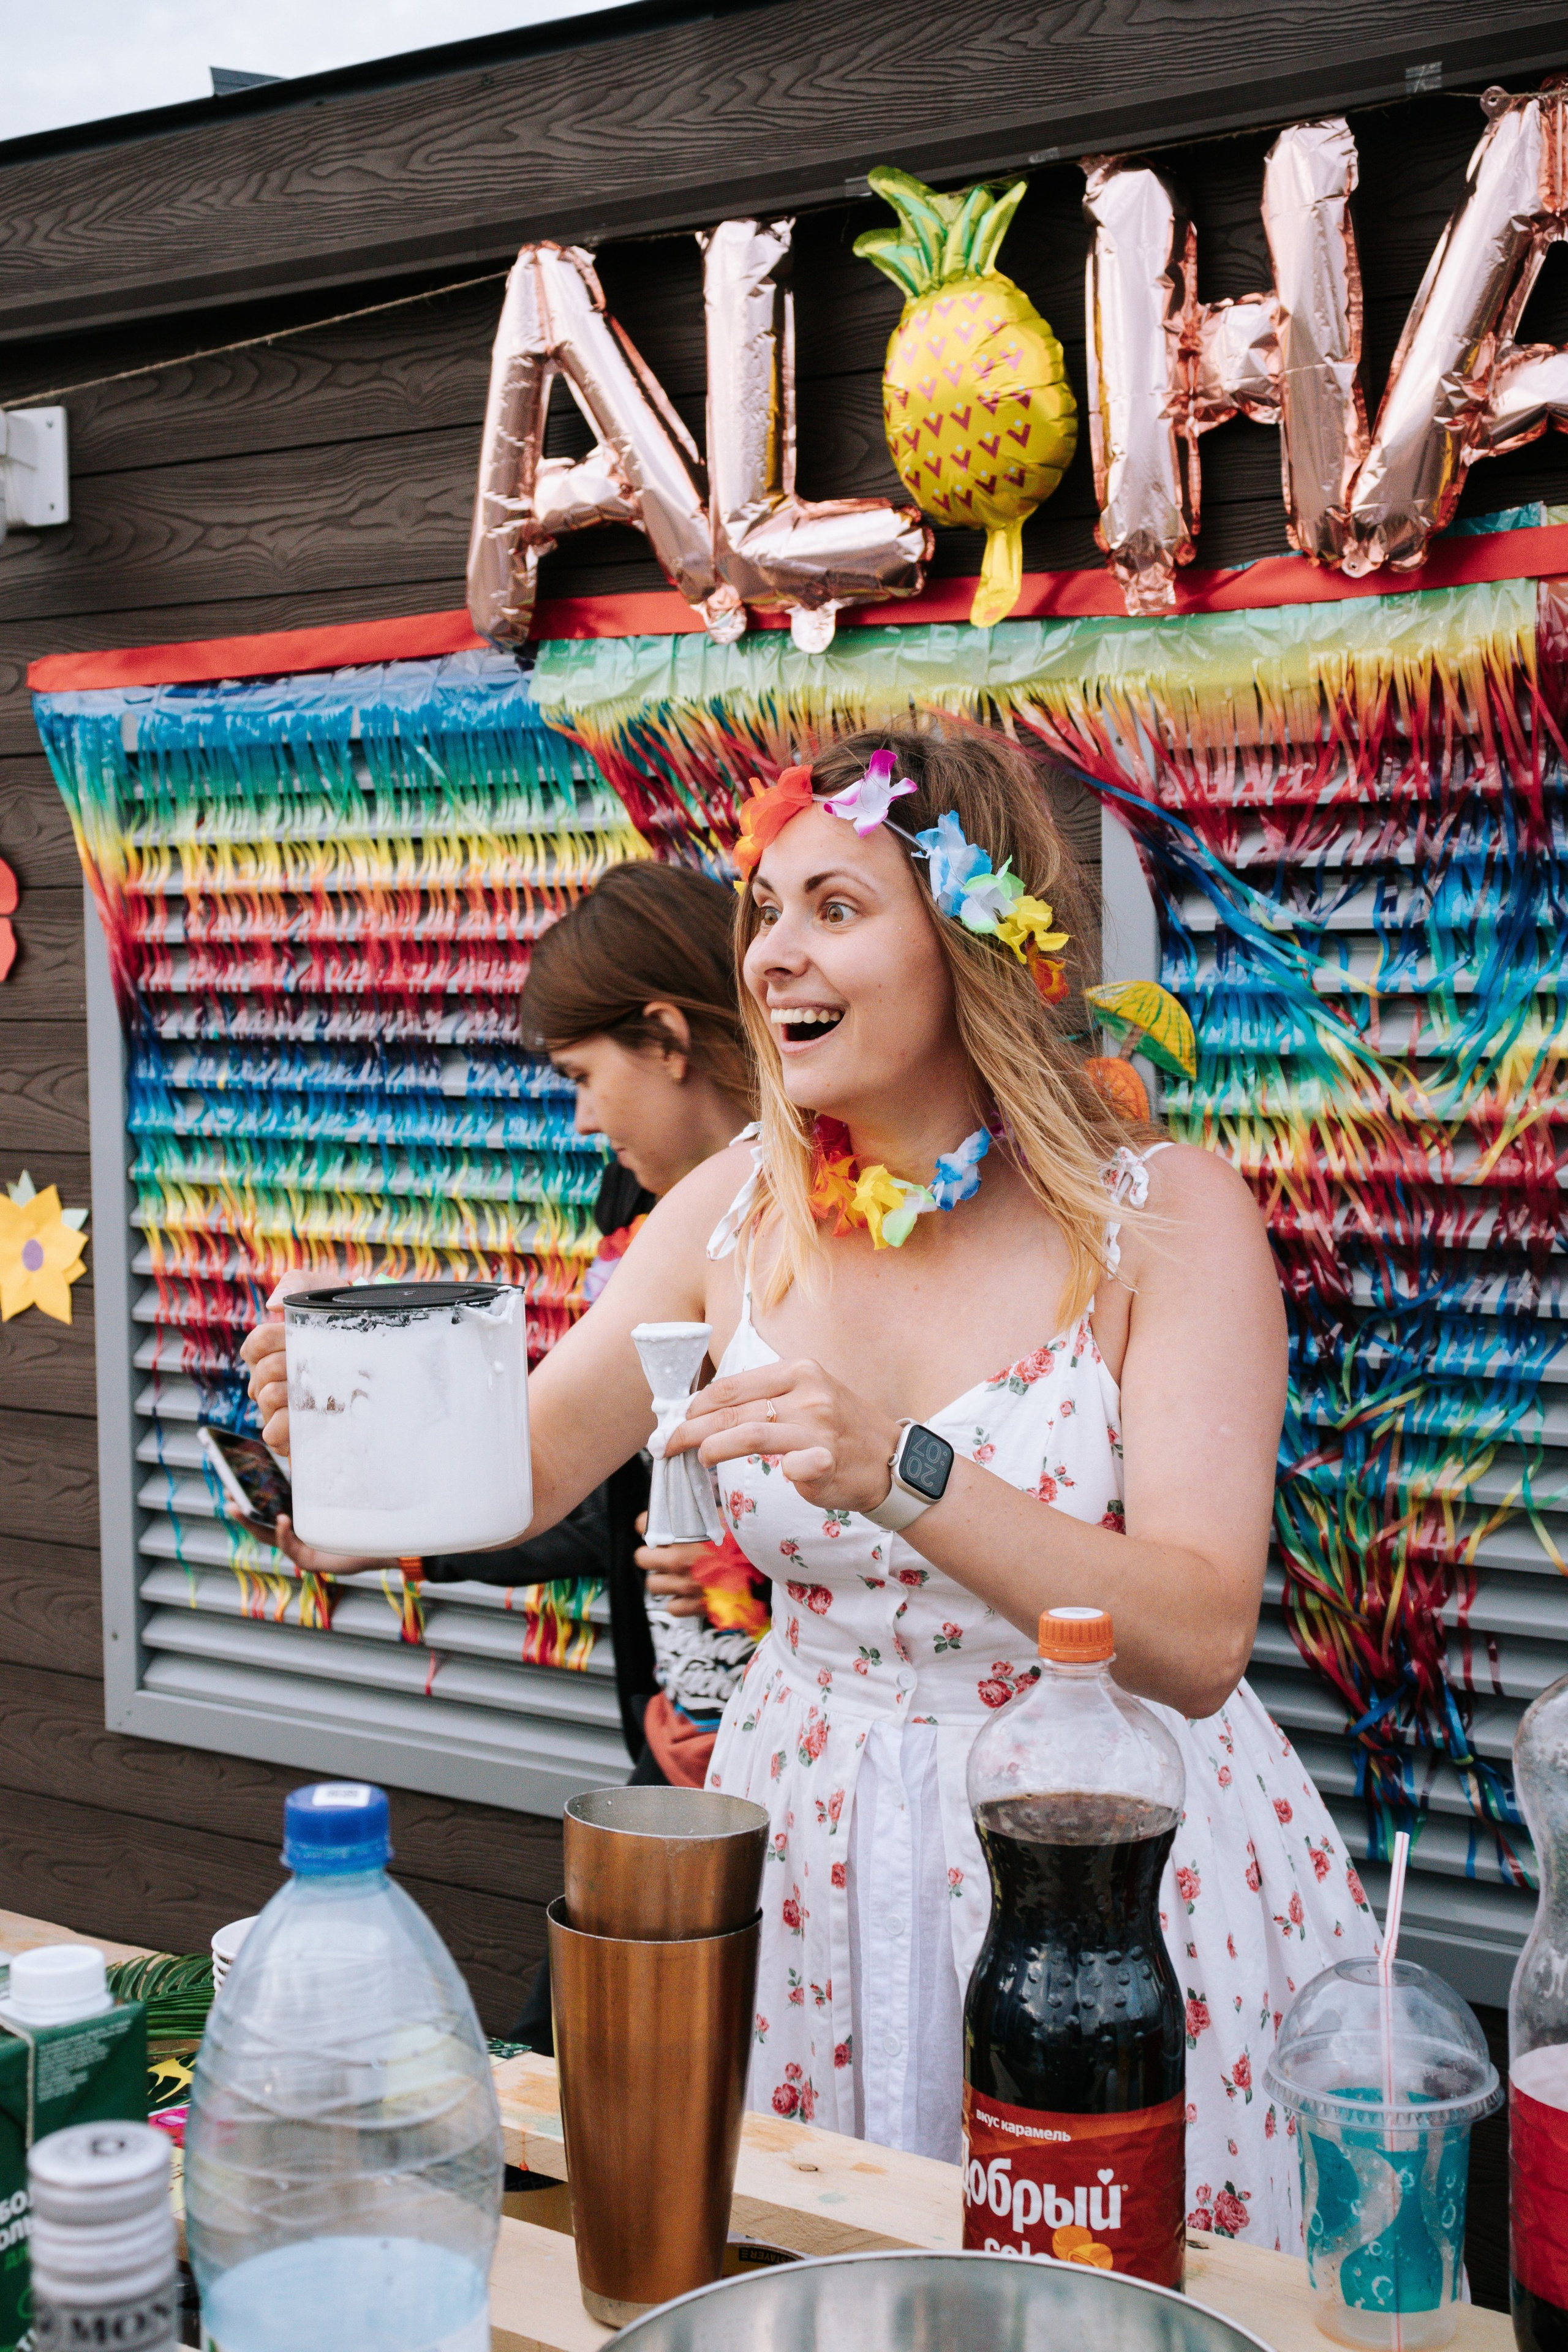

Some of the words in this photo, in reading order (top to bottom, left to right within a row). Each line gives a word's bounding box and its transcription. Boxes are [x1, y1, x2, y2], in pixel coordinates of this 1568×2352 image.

[907, 1455, 938, 1487] 20
[976, 2109, 1000, 2128] вкус
[1001, 2120, 1071, 2143] карамель
